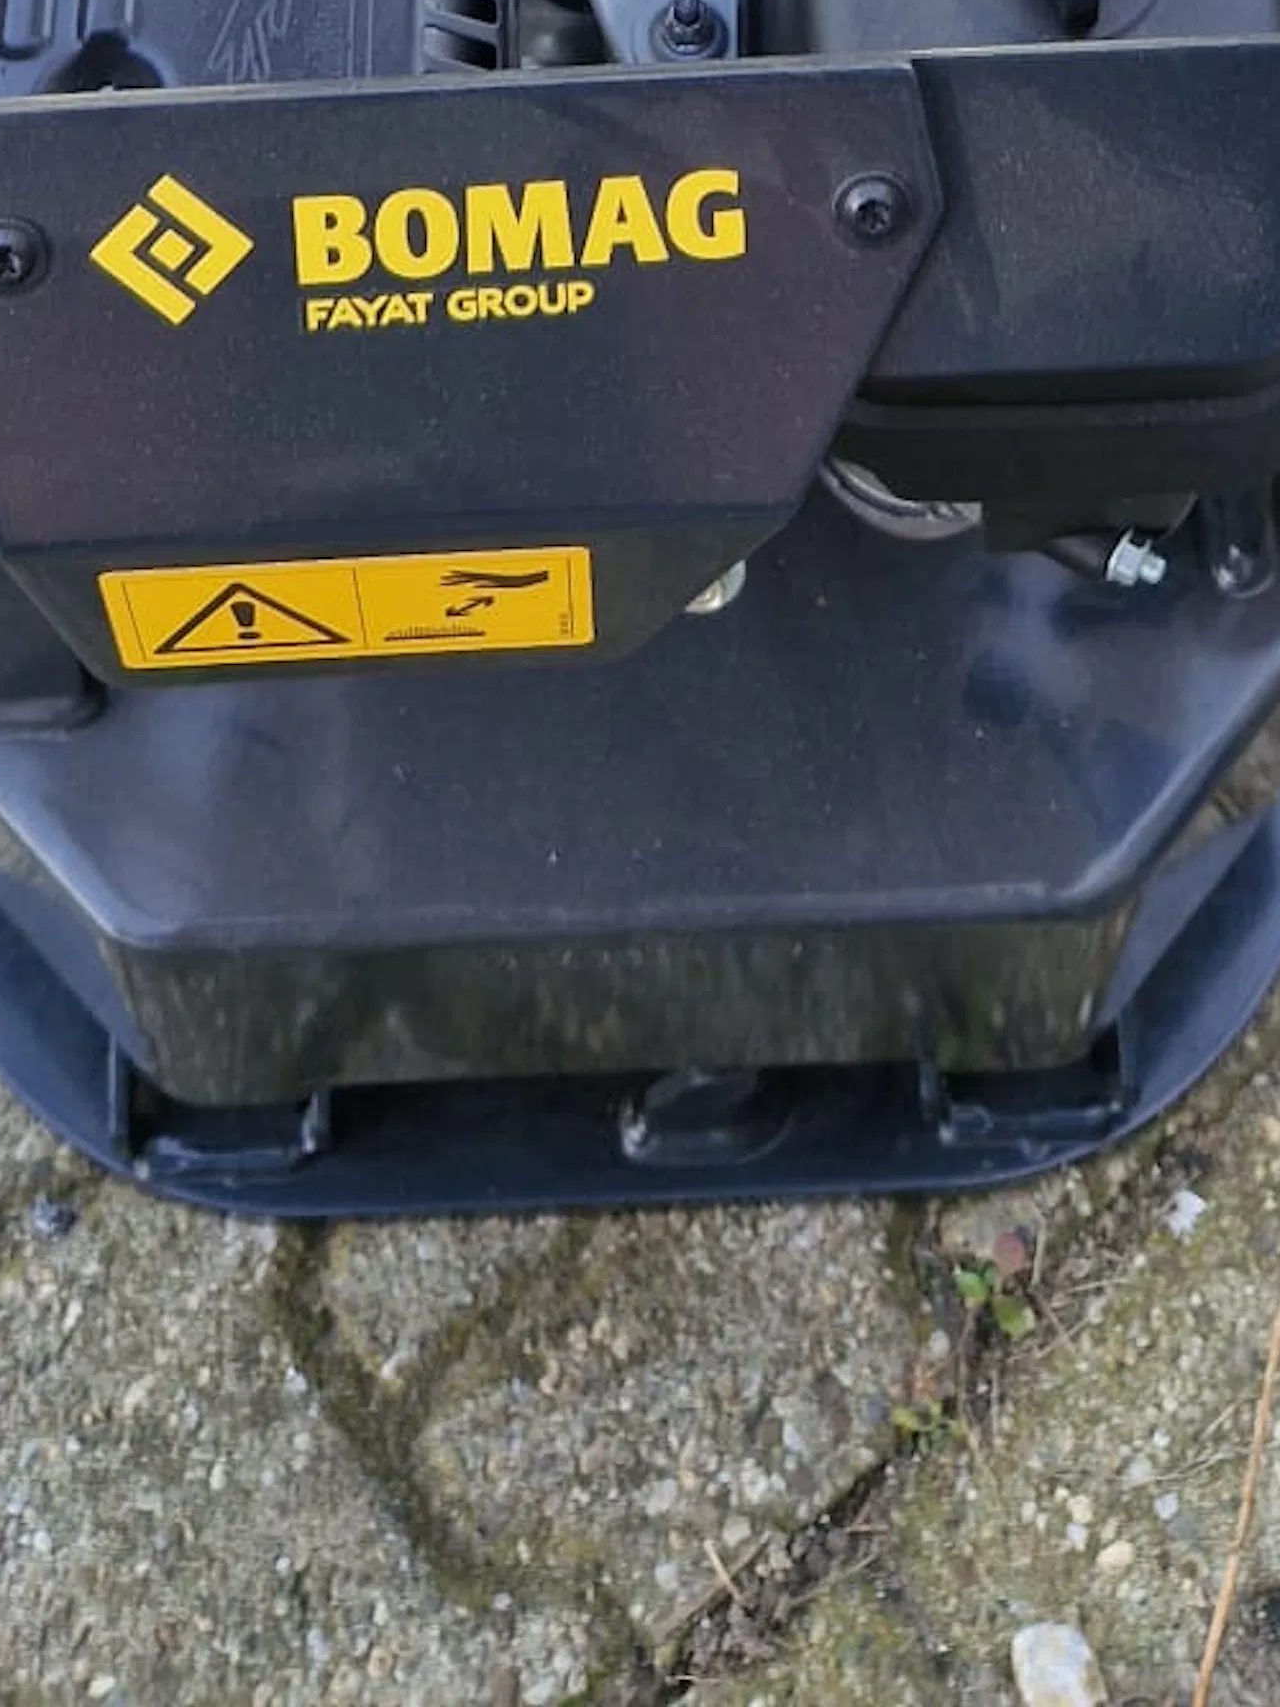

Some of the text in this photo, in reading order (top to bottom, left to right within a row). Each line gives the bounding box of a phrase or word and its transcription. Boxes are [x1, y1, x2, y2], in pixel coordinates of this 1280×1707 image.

[292, 169, 748, 286] BOMAG
[304, 279, 596, 333] FAYAT GROUP
